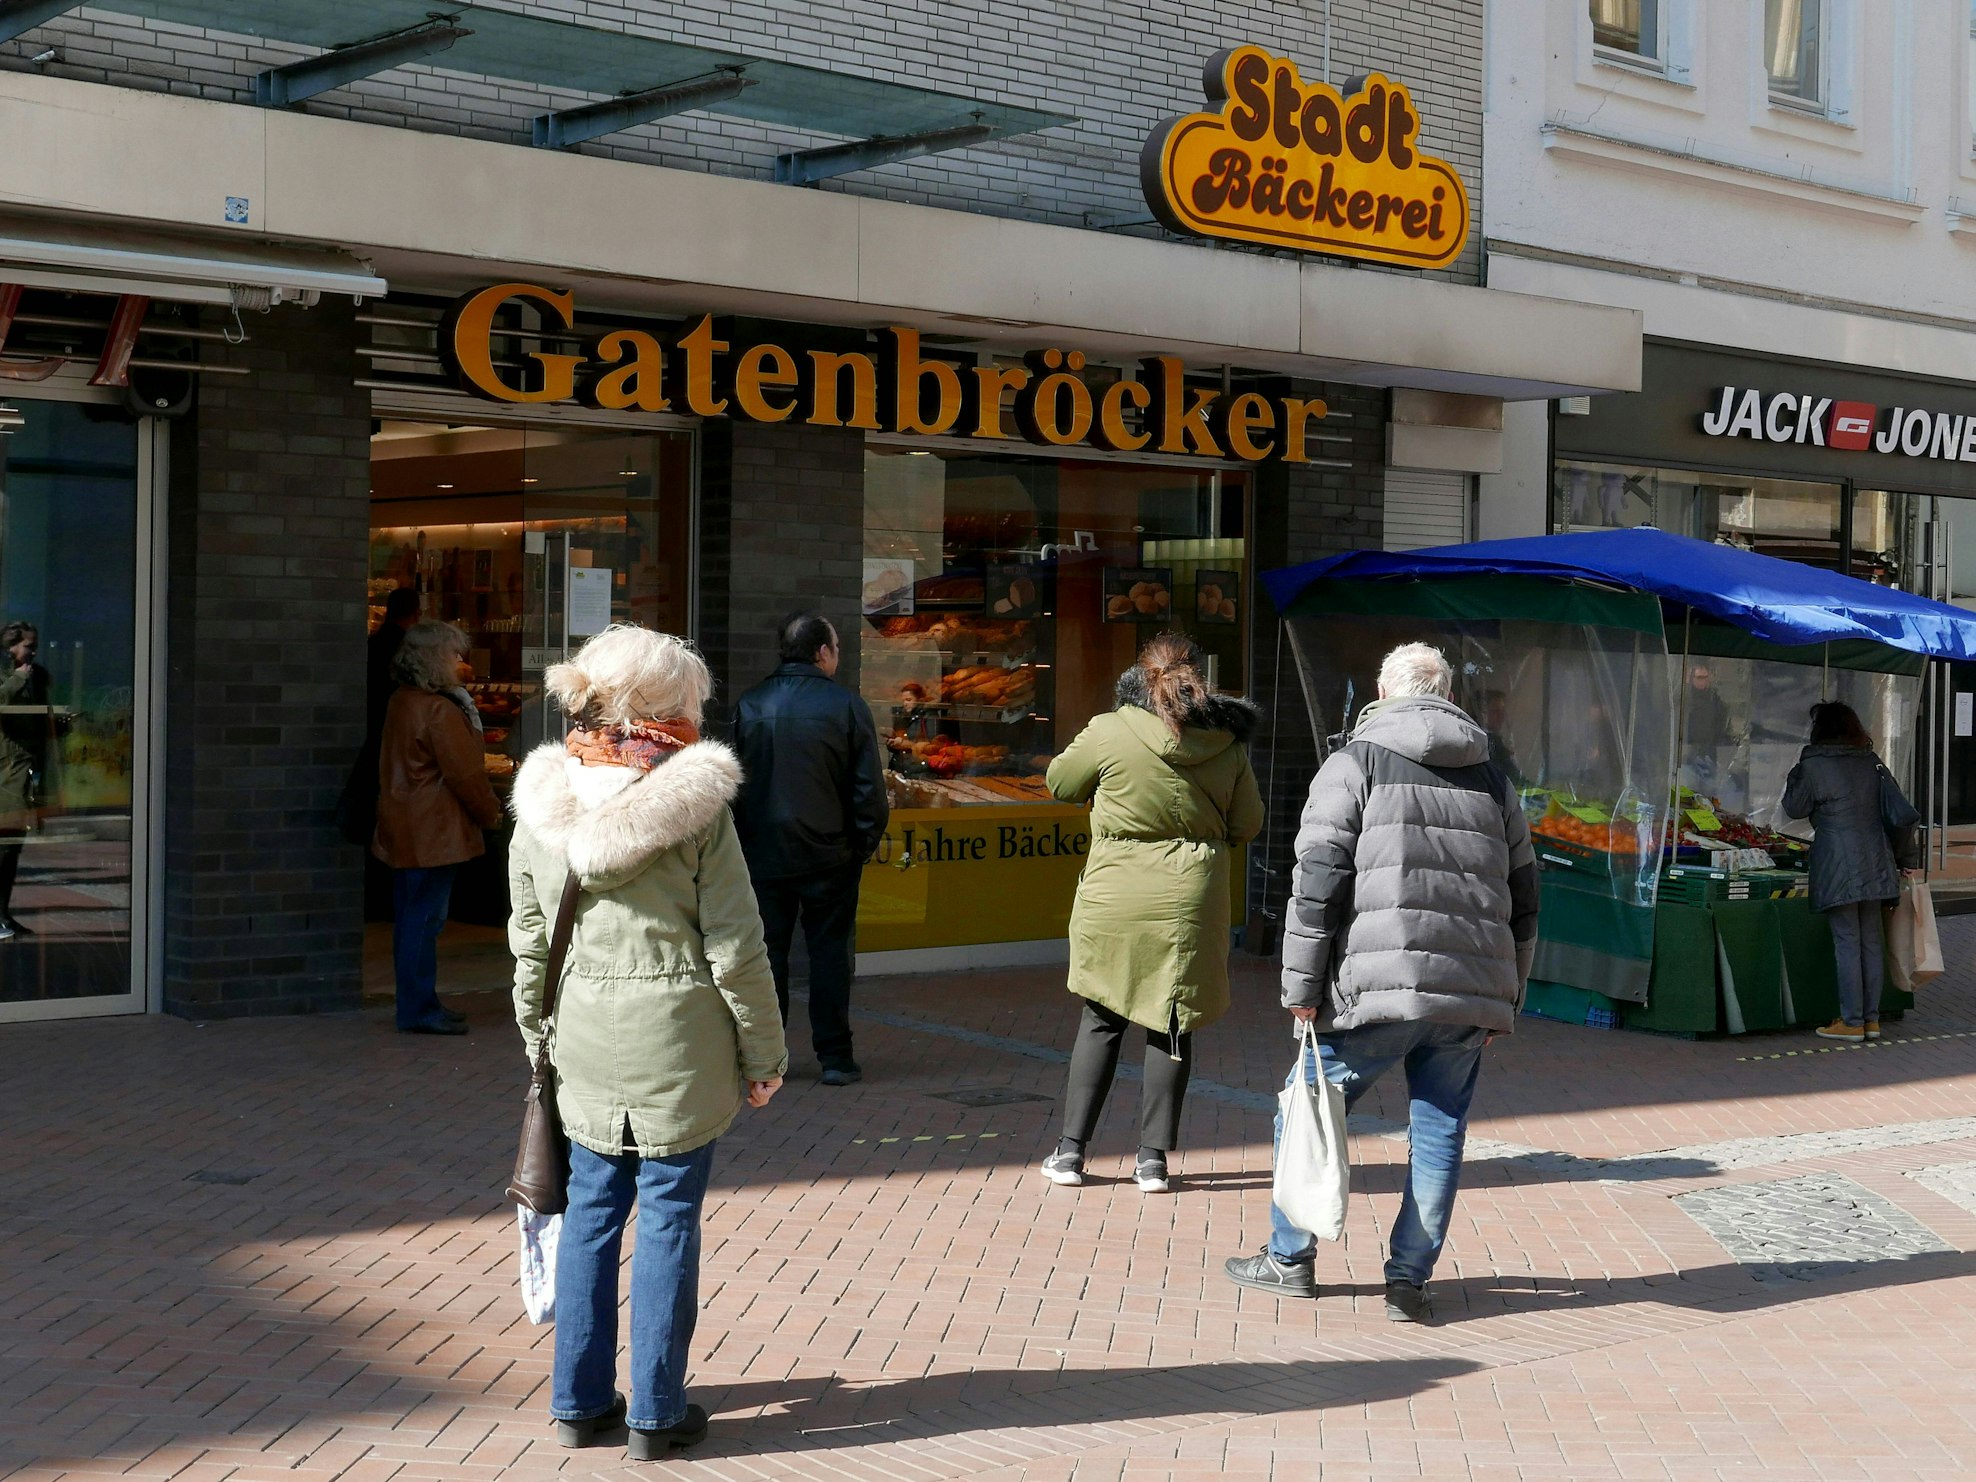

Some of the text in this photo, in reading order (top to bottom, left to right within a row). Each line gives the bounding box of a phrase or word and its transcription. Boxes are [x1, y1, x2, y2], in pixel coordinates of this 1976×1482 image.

[1231, 54, 1412, 169] Stadt
[1192, 148, 1445, 240] Bäckerei
[453, 283, 1328, 463] Gatenbröcker
[1703, 386, 1976, 462] JACK JONE
[901, 826, 987, 867] Jahre
[997, 823, 1091, 859] Bäcke
